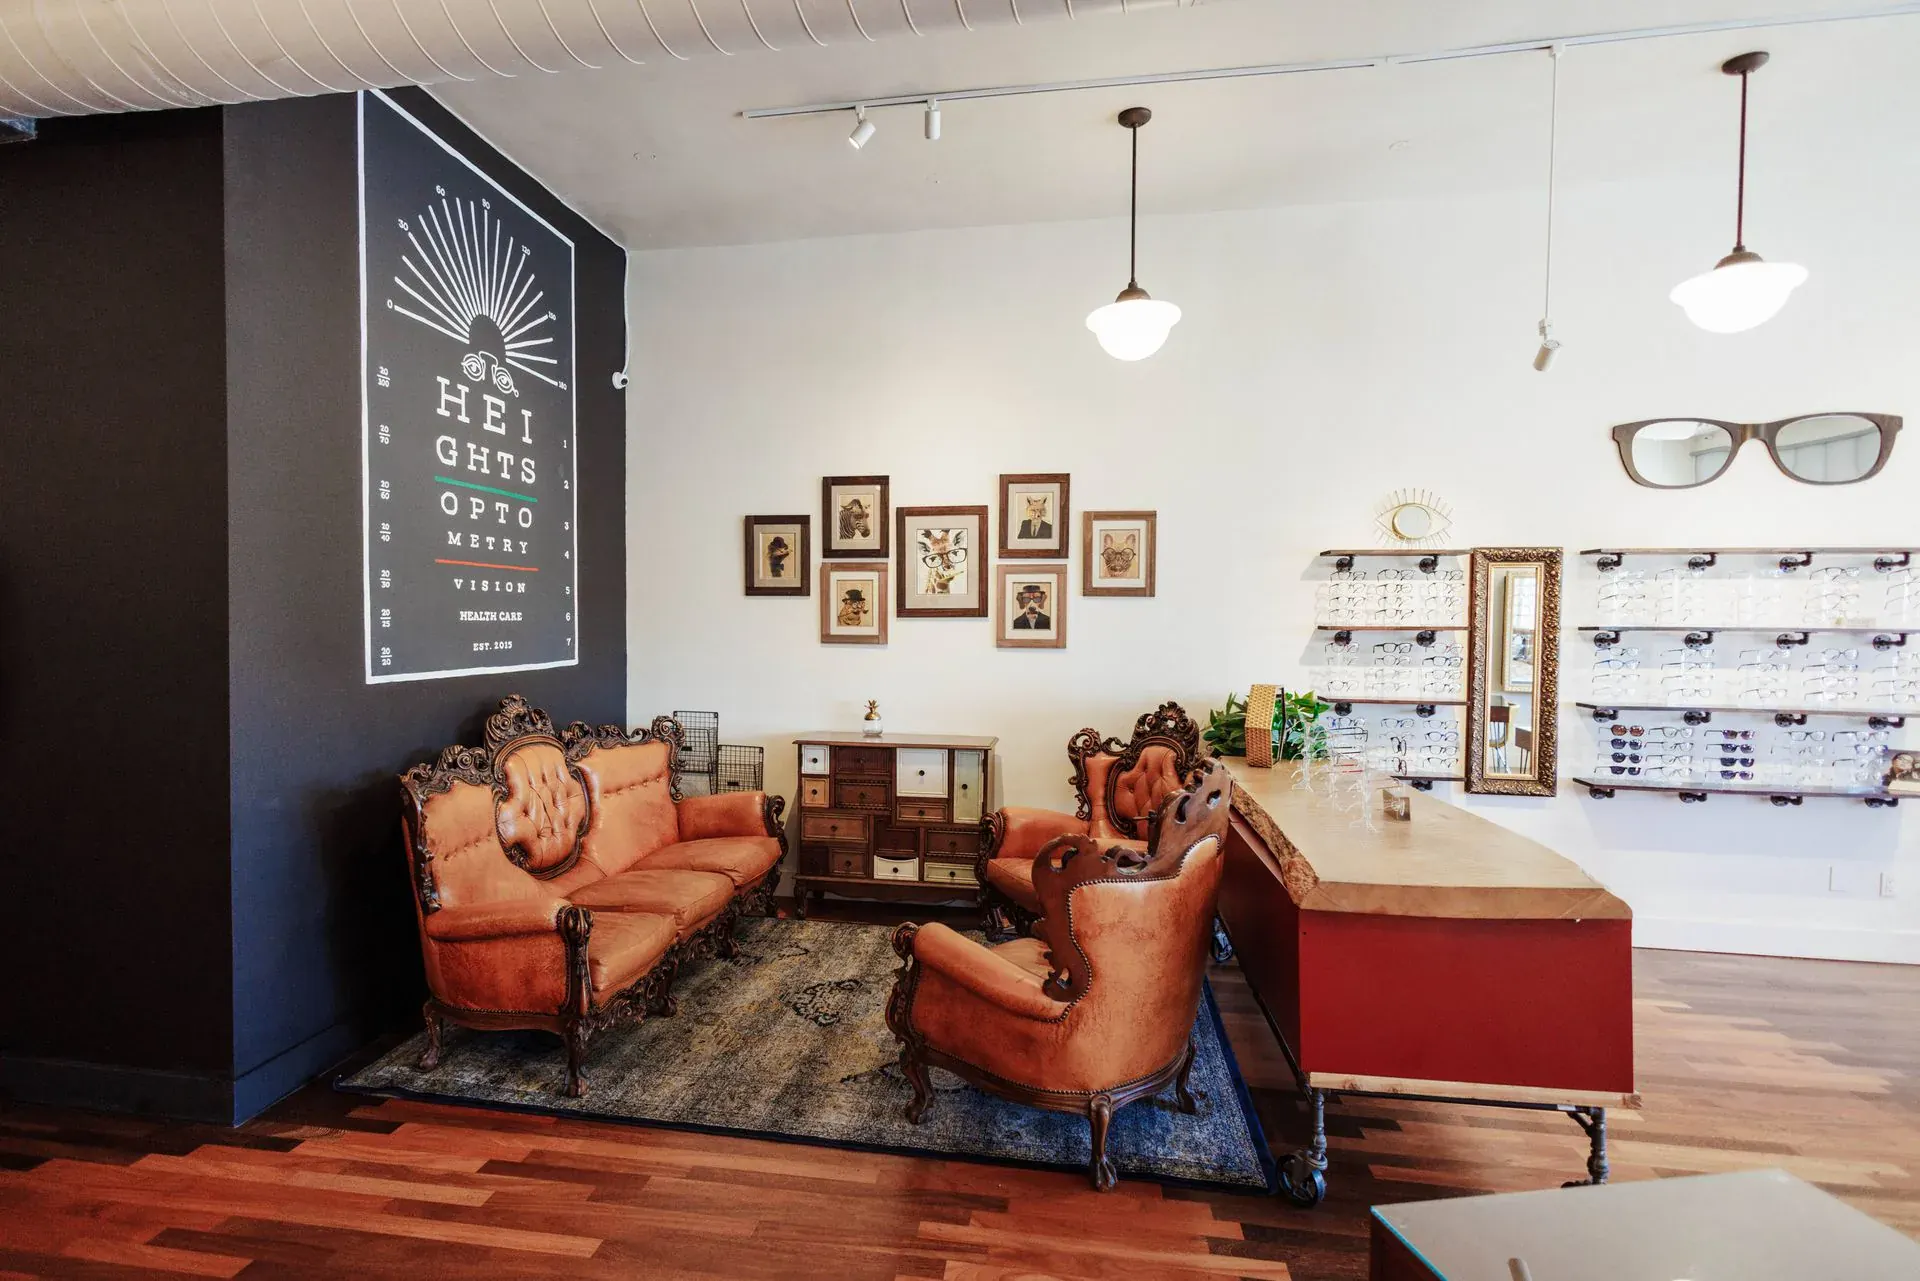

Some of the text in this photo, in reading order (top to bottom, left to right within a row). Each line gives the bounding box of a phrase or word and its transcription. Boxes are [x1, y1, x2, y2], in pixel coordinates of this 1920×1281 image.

[435, 184, 446, 197] 60
[397, 219, 409, 232] 30
[436, 376, 533, 444] HEI
[379, 424, 389, 434] 20
[379, 436, 390, 445] 70
[436, 435, 536, 484] GHTS
[380, 480, 390, 489] 20
[563, 480, 570, 490] 2
[440, 491, 533, 529] OPTO
[564, 522, 570, 531] 3
[447, 531, 529, 555] METRY
[564, 550, 570, 560] 4
[380, 569, 391, 578] 20
[453, 578, 526, 593] VISION
[565, 586, 571, 595] 5
[380, 608, 391, 617] 20
[459, 610, 523, 621] HEALTH CARE
[565, 612, 571, 622] 6
[472, 640, 513, 651] EST. 2015
[566, 637, 572, 647] 7
[380, 647, 391, 655] 20
[381, 657, 392, 666] 20
